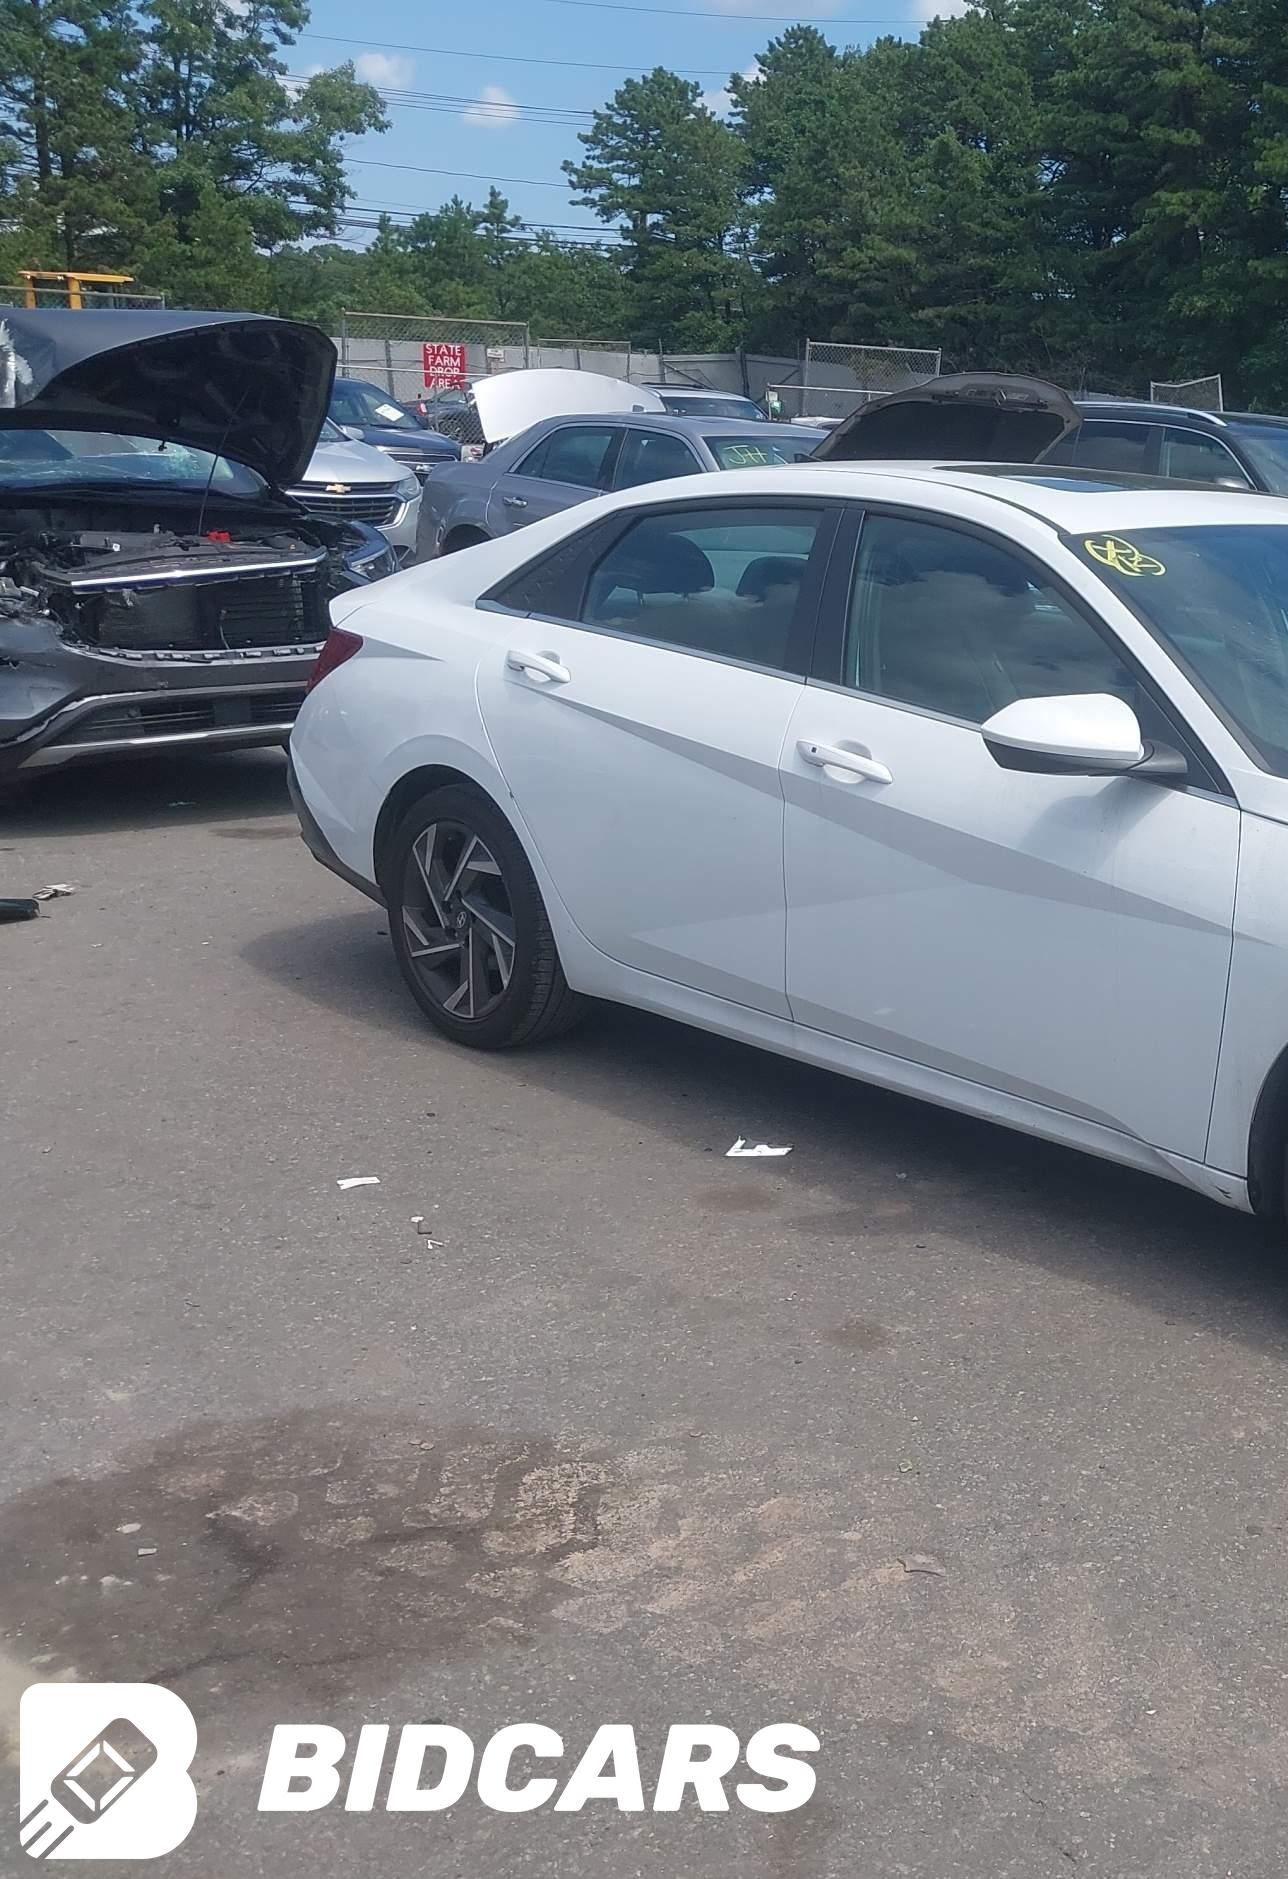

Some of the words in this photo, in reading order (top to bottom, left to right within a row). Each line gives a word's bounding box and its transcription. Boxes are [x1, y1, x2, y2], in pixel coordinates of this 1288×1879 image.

[425, 344, 462, 356] STATE
[428, 355, 461, 367] FARM
[429, 366, 460, 378] DROP
